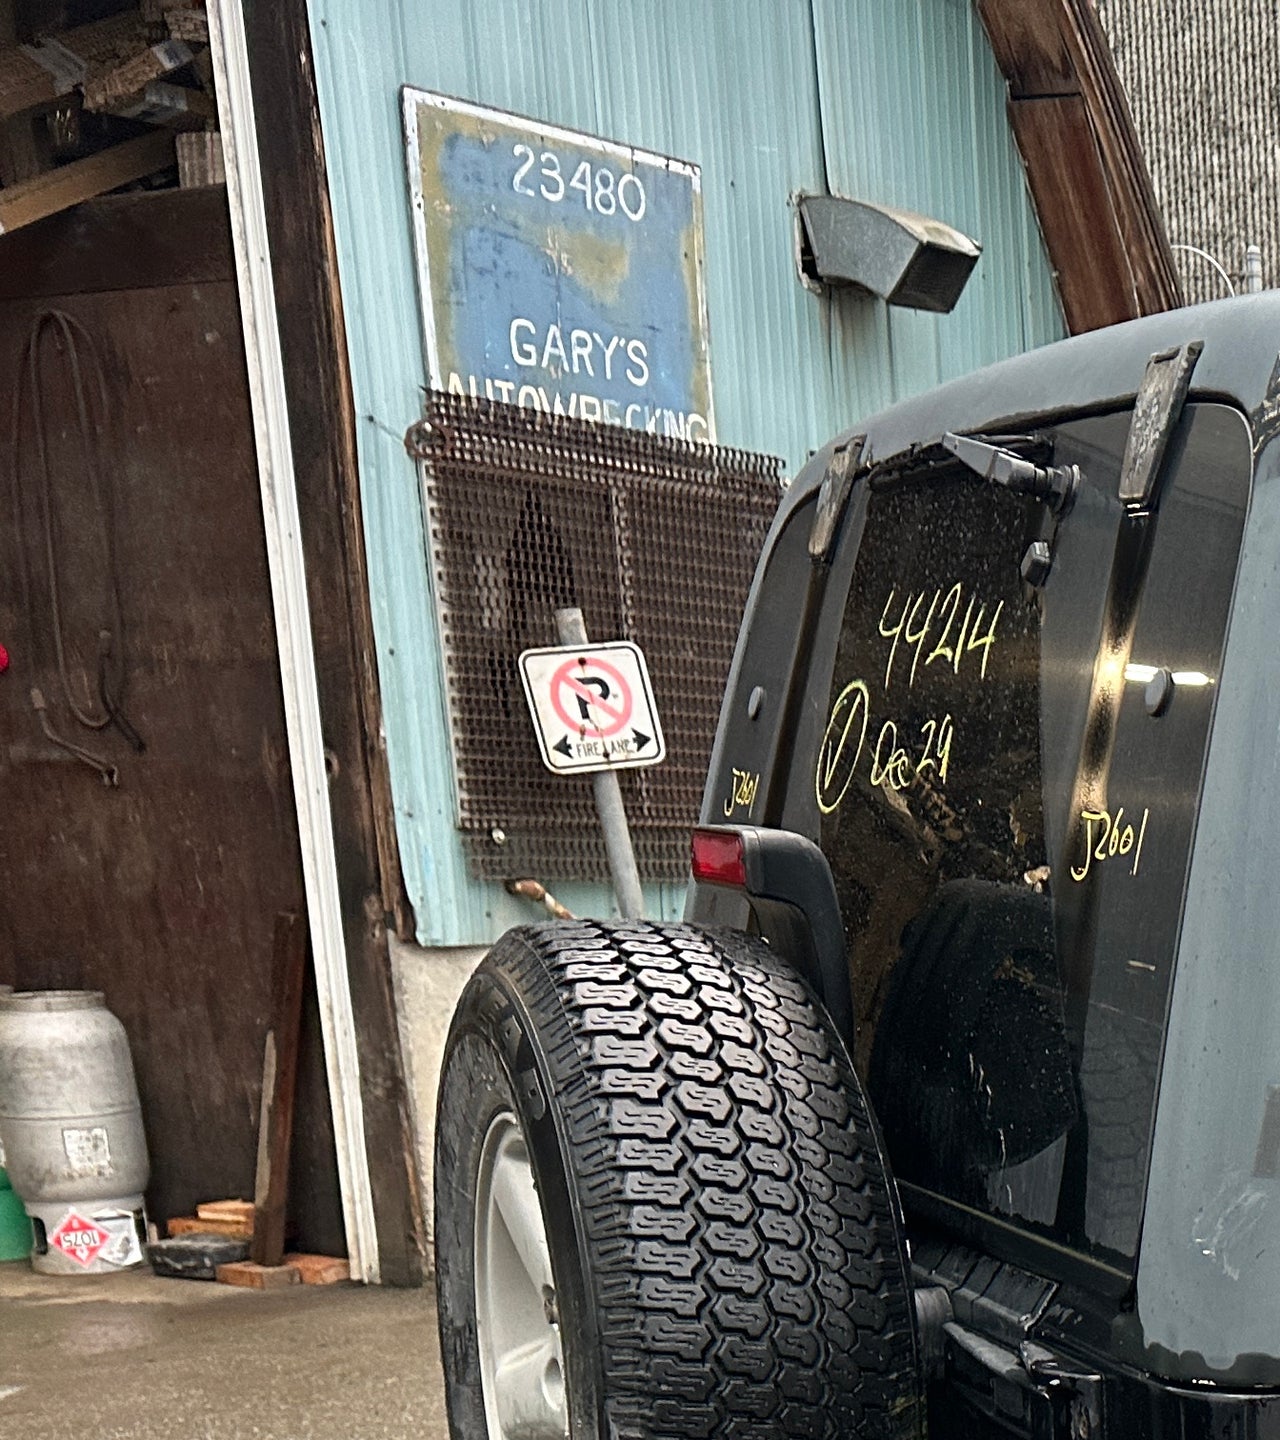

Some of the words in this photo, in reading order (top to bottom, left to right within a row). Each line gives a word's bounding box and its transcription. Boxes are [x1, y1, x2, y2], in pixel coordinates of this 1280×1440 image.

[512, 143, 647, 222] 23480
[509, 317, 650, 388] GARY'S
[878, 582, 1004, 690] 44214
[575, 742, 601, 758] FIRE
[1069, 807, 1150, 882] J2601
[62, 1231, 98, 1248] 1075
